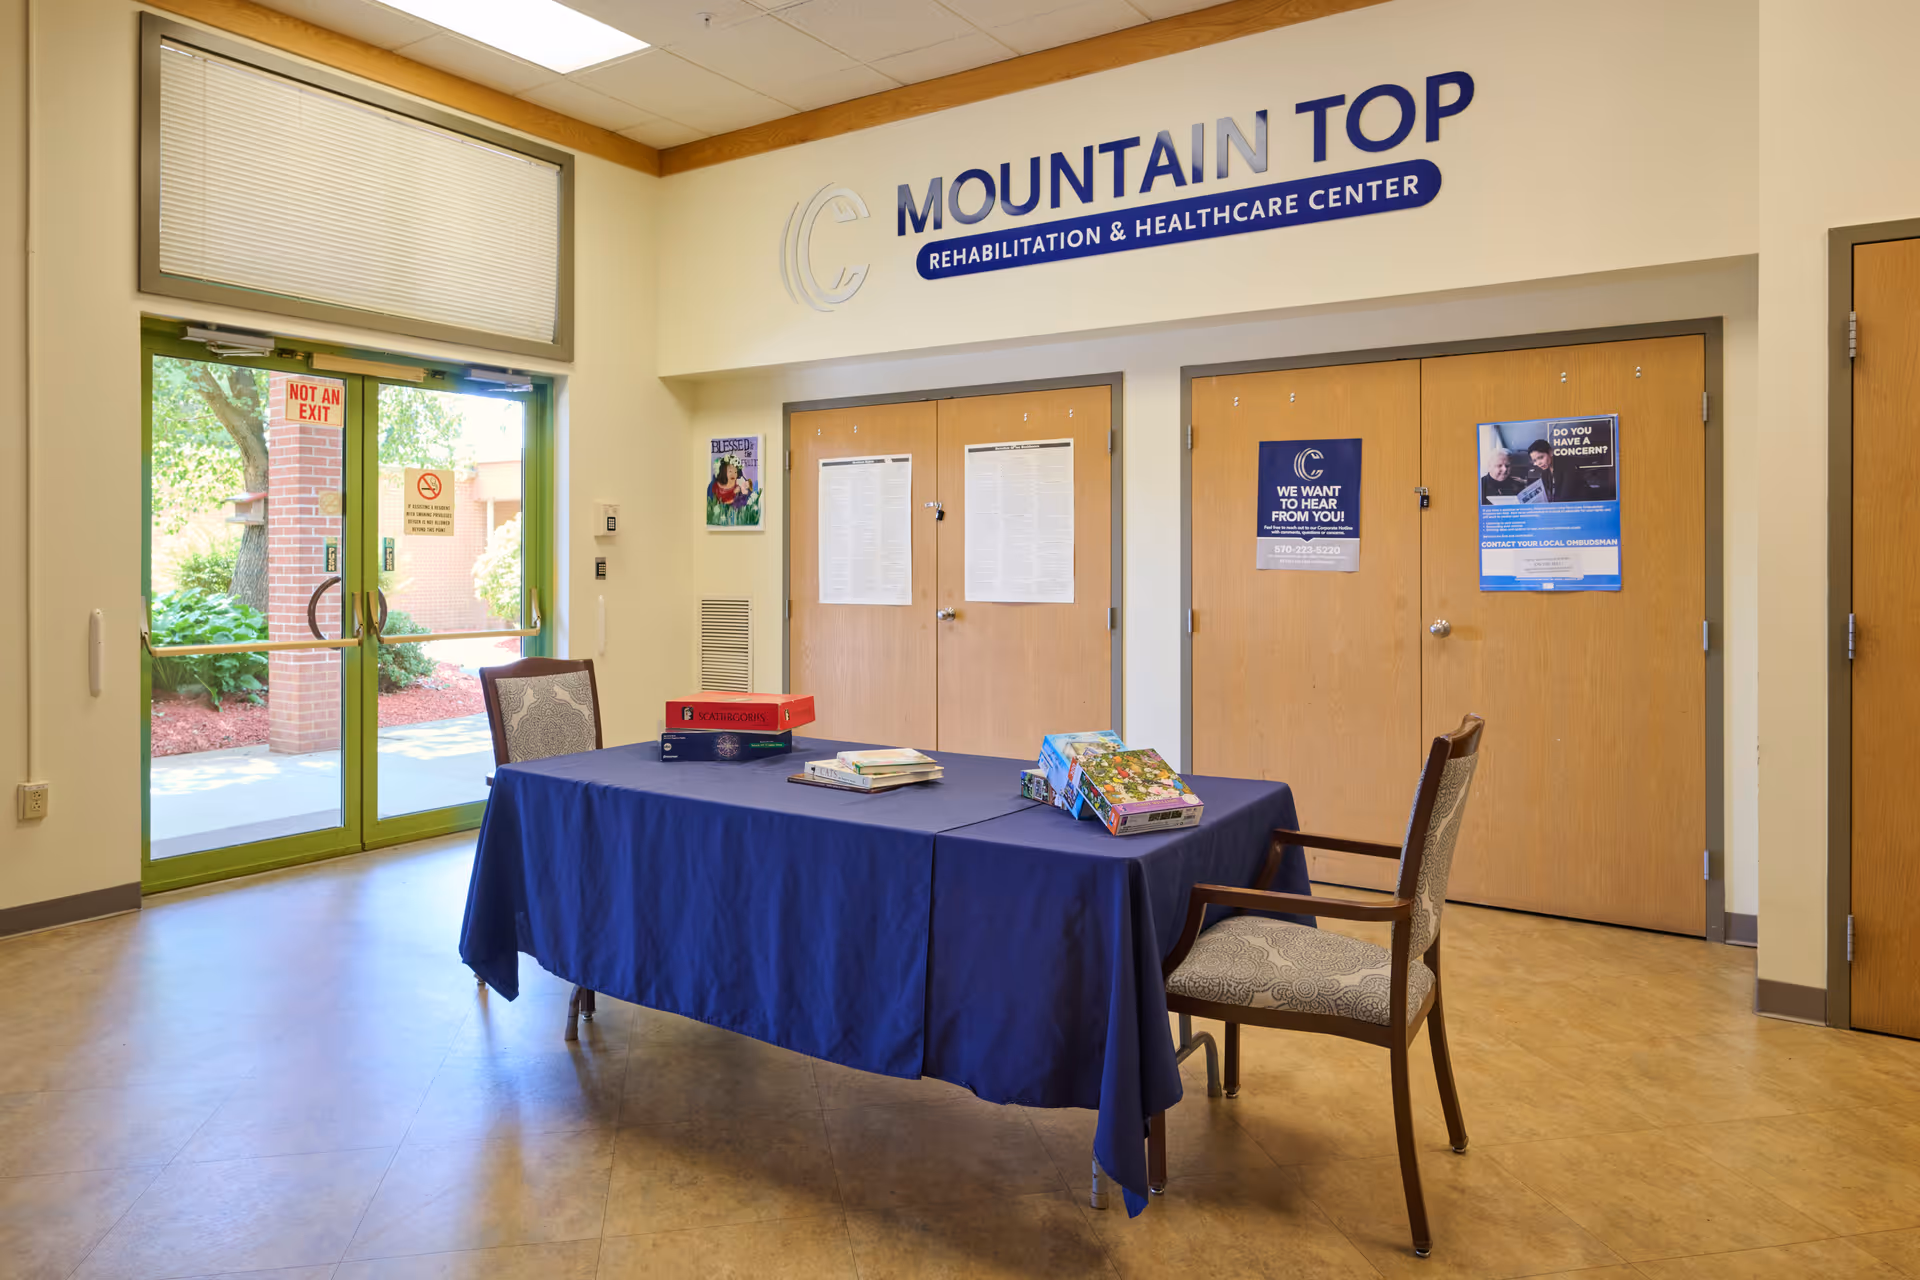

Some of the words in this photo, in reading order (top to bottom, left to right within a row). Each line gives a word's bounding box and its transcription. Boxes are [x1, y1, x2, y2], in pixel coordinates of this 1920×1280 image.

[897, 108, 1268, 237] MOUNTAIN
[1295, 71, 1475, 163] TOP
[929, 225, 1101, 270] REHABILITATION
[1109, 220, 1126, 242] &
[1135, 193, 1299, 238] HEALTHCARE
[1308, 174, 1420, 210] CENTER
[290, 383, 318, 402] NOT
[321, 387, 340, 406] AN
[299, 402, 331, 422] EXIT
[1553, 428, 1569, 437] DO
[1570, 426, 1592, 436] YOU
[711, 439, 750, 454] BLESSED
[1553, 437, 1581, 446] HAVE
[1582, 436, 1591, 445] A
[1553, 445, 1608, 456] CONCERN?
[1277, 486, 1298, 497] WE
[1300, 485, 1342, 497] WANT
[1280, 498, 1298, 509] TO
[1301, 498, 1338, 510] HEAR
[1271, 511, 1309, 522] FROM
[1312, 511, 1345, 522] YOU!
[1274, 545, 1341, 555] 570-223-5220
